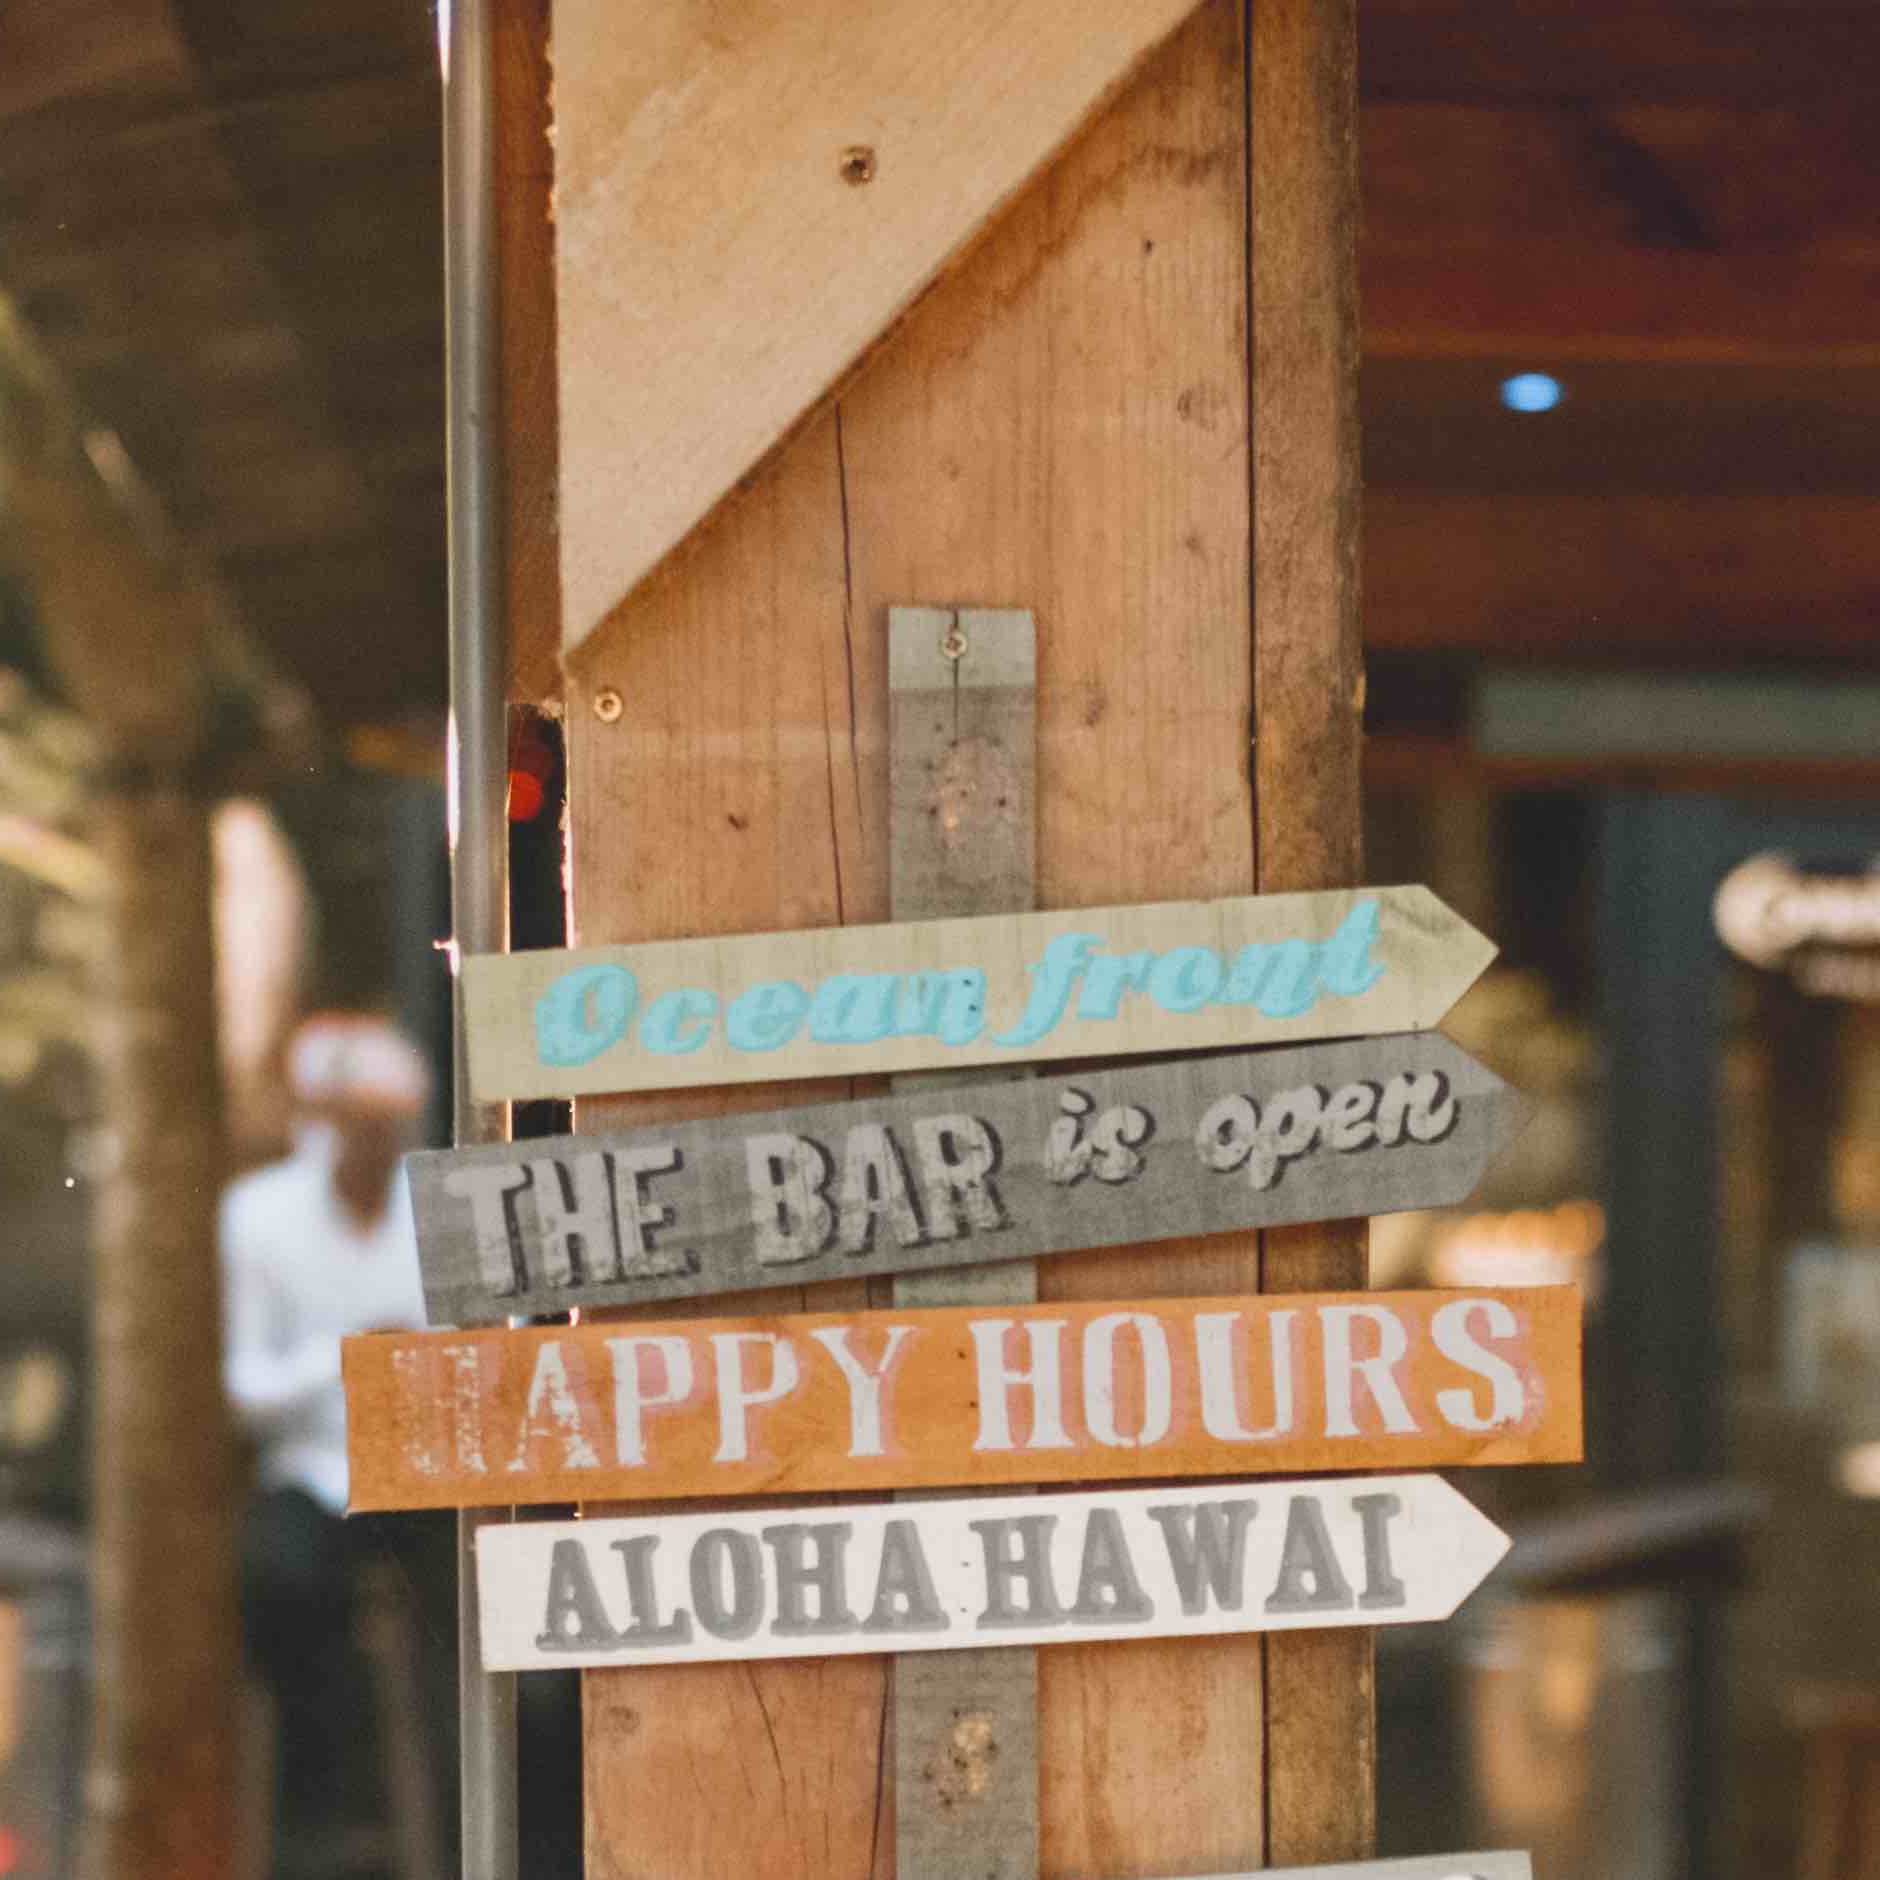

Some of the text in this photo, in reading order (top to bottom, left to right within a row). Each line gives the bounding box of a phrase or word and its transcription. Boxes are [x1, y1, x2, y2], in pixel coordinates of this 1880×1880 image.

[532, 901, 1388, 1067] Ocean front
[444, 1067, 1463, 1298] THE BAR is open
[971, 1298, 1530, 1452] HOURS
[535, 1491, 1405, 1653] ALOHA HAWAI
